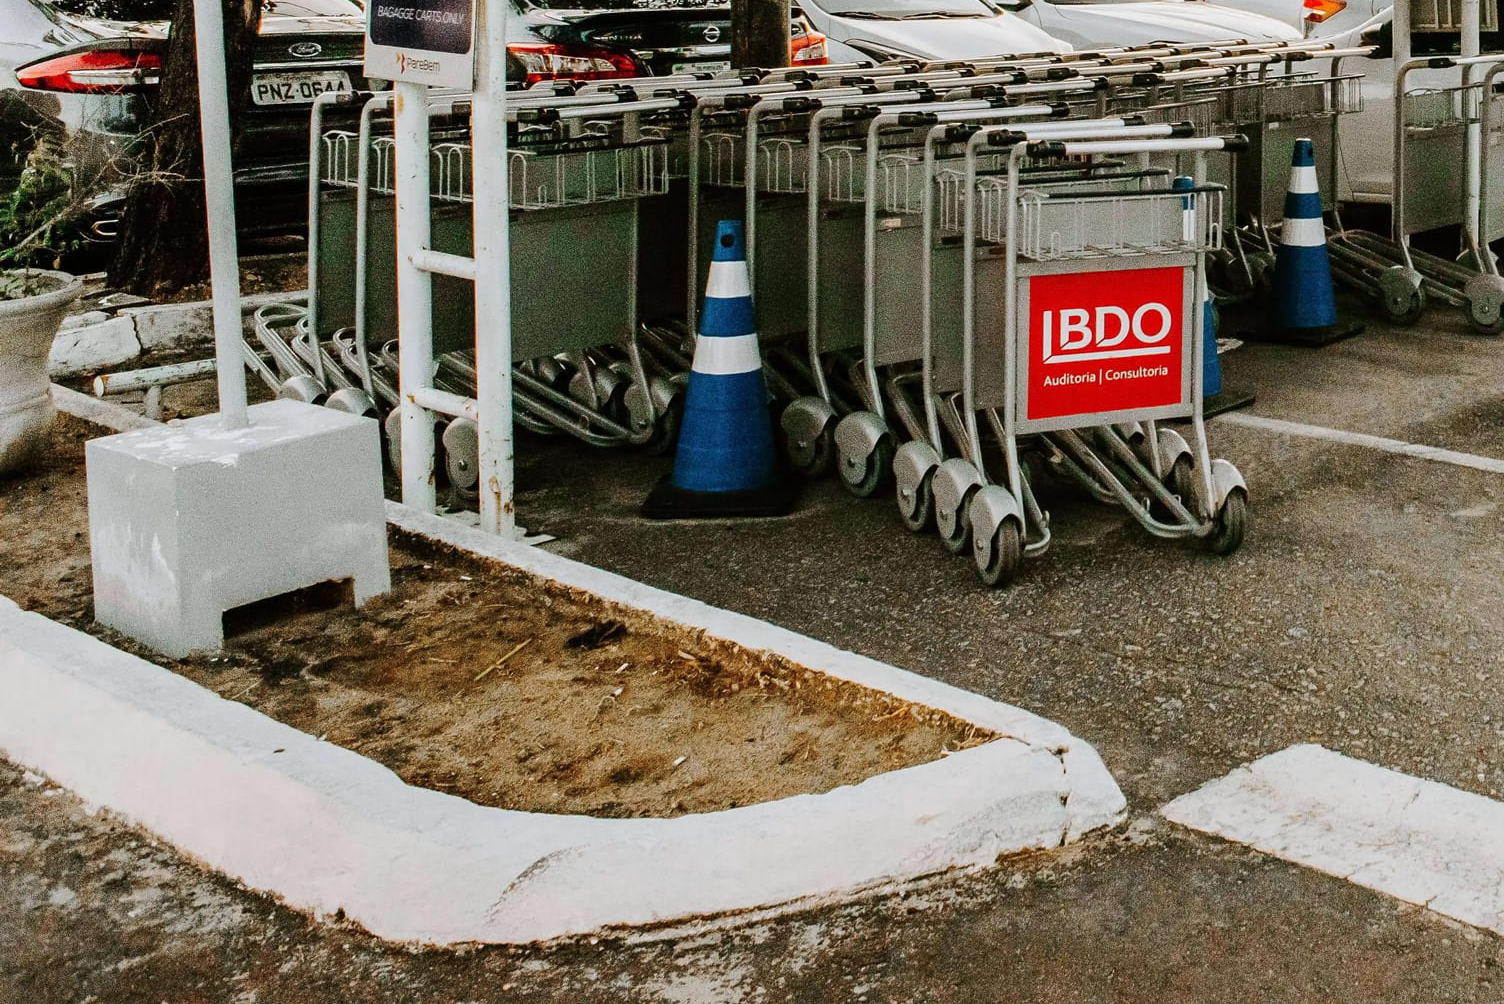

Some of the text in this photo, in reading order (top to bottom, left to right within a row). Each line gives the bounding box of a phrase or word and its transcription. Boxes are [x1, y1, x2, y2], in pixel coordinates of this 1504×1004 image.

[377, 6, 465, 25] BAGAGGE CARTS ONLY
[1059, 302, 1172, 351] BDO
[1043, 371, 1096, 387] Auditoria
[1105, 365, 1169, 381] Consultoria
